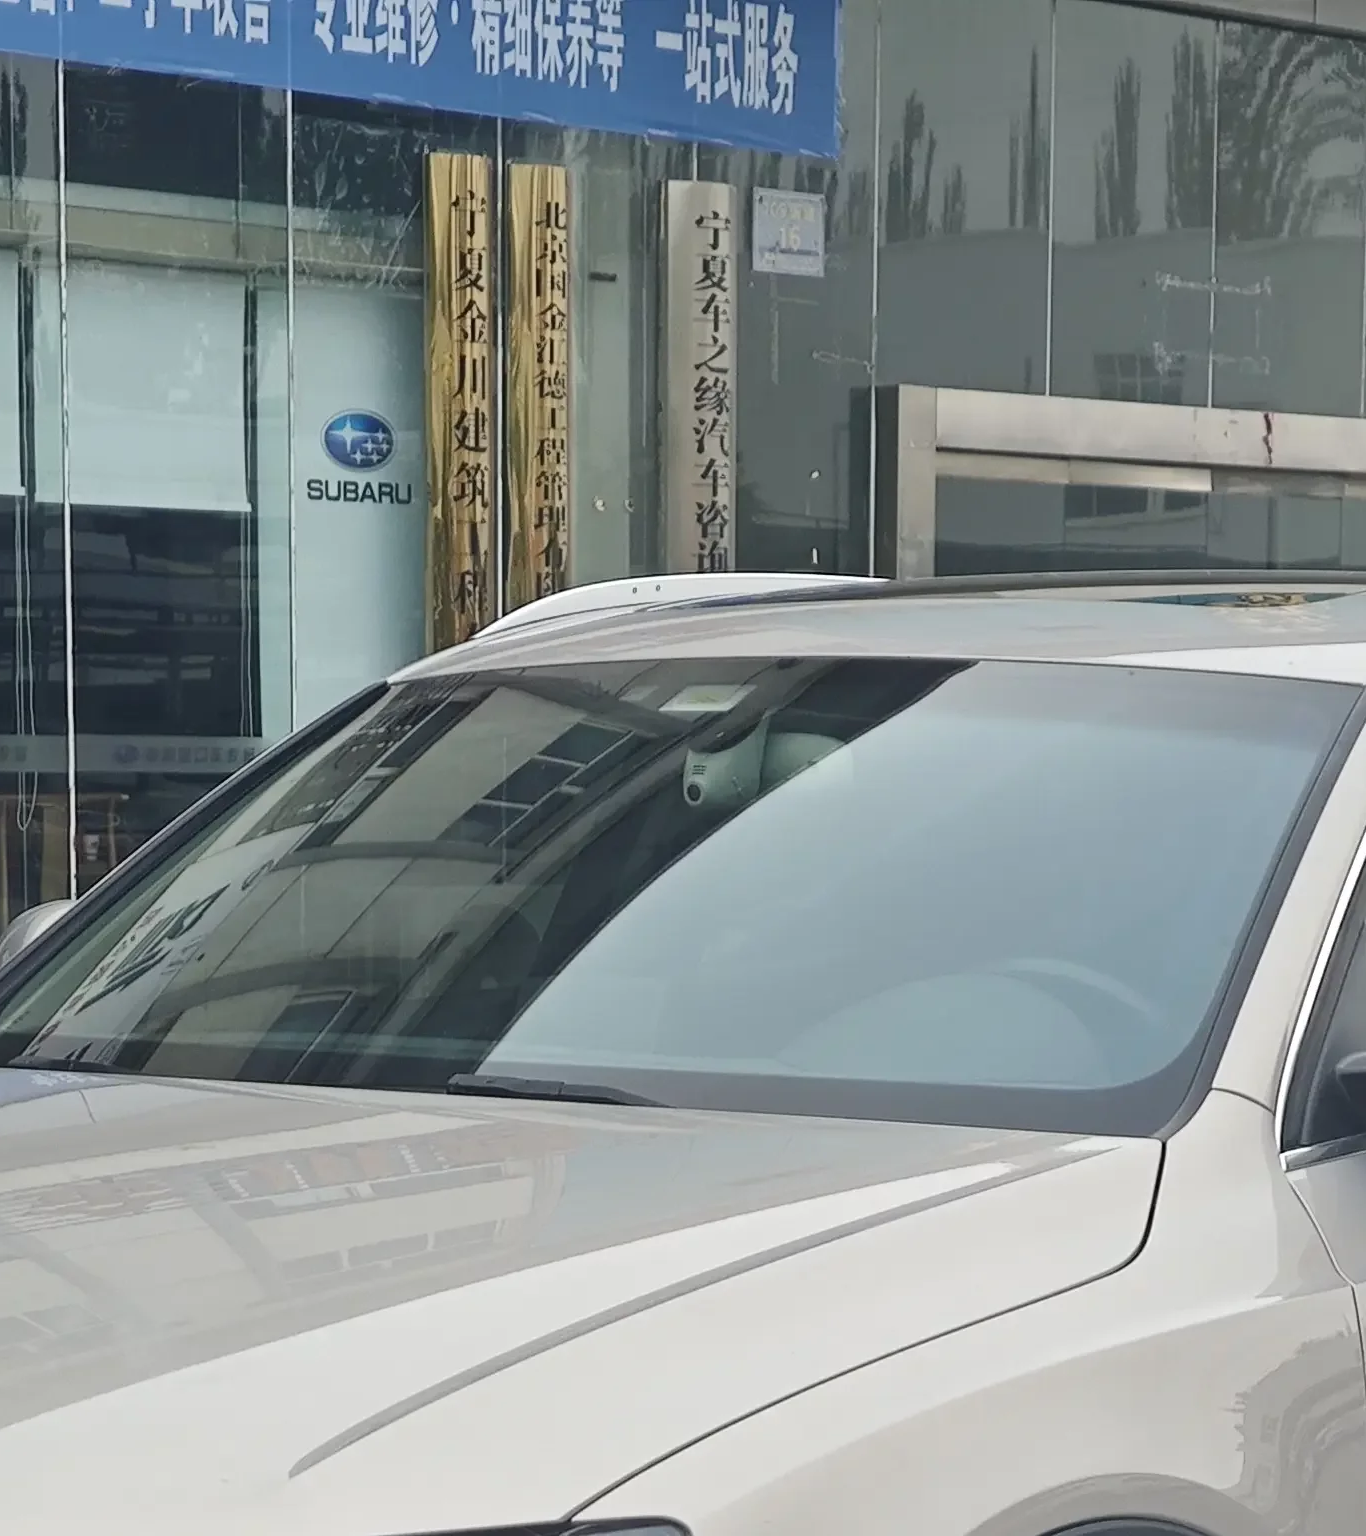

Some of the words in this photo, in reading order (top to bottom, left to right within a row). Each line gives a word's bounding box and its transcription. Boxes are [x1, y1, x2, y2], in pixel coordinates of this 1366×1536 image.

[654, 0, 801, 116] 一站式服务
[306, 477, 414, 506] SUBARU
[451, 189, 489, 637] 宁夏金川建筑工程
[691, 210, 732, 573] 宁夏车之缘汽车咨询
